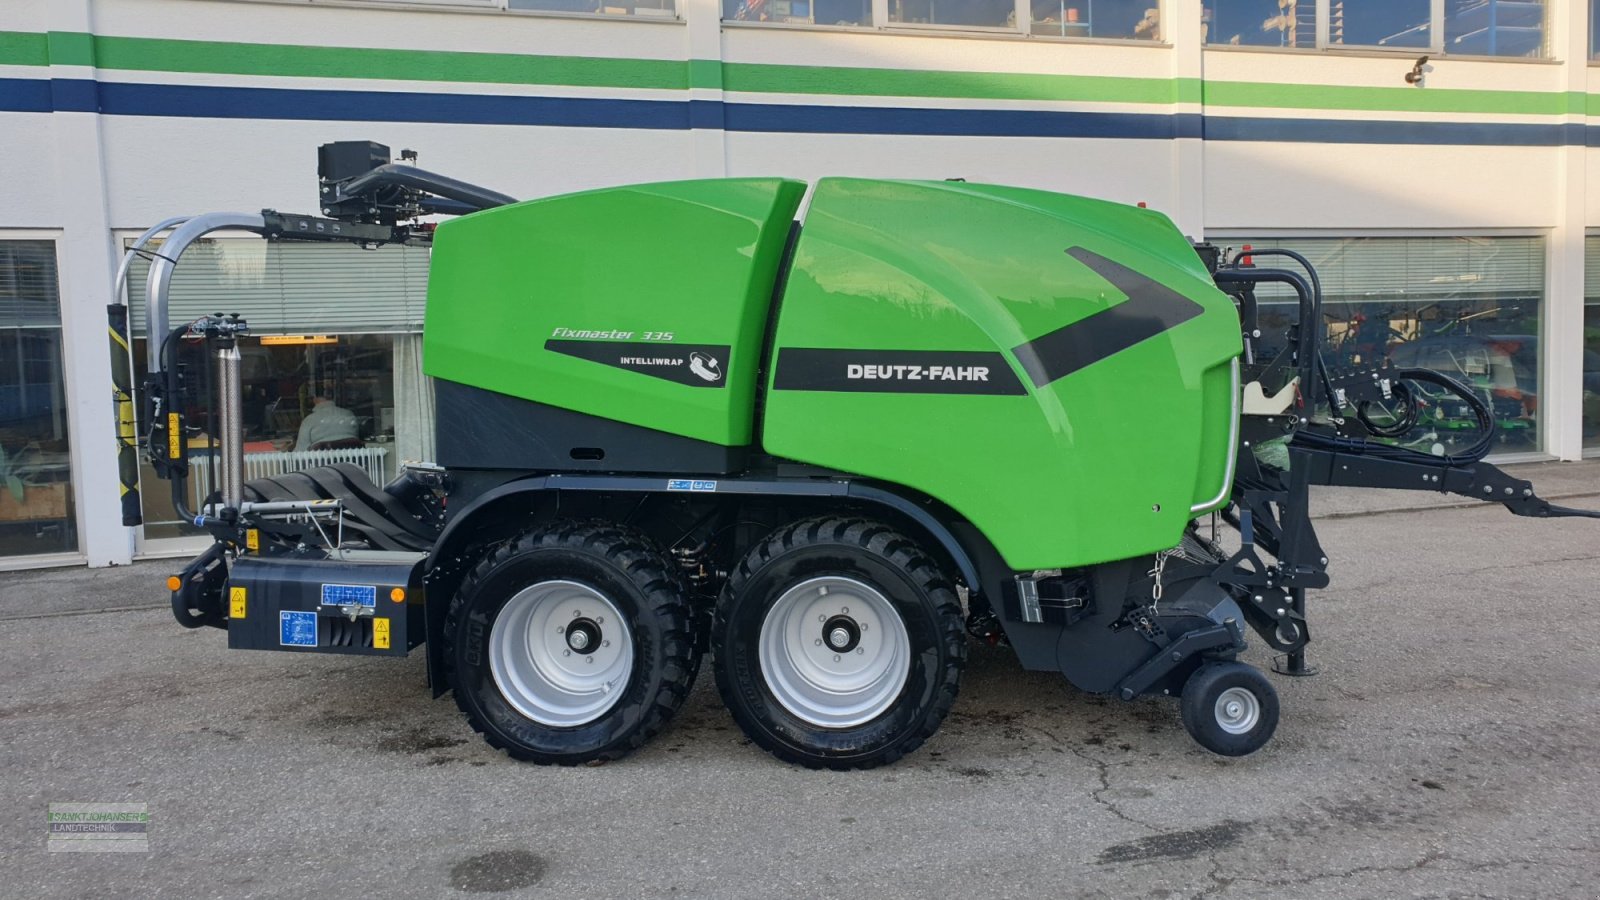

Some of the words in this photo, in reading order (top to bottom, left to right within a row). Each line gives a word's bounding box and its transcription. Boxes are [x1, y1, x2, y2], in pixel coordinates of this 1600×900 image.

[552, 327, 635, 340] Fixmaster
[640, 331, 675, 341] 335
[620, 356, 684, 366] INTELLIWRAP
[847, 364, 990, 382] DEUTZ-FAHR
